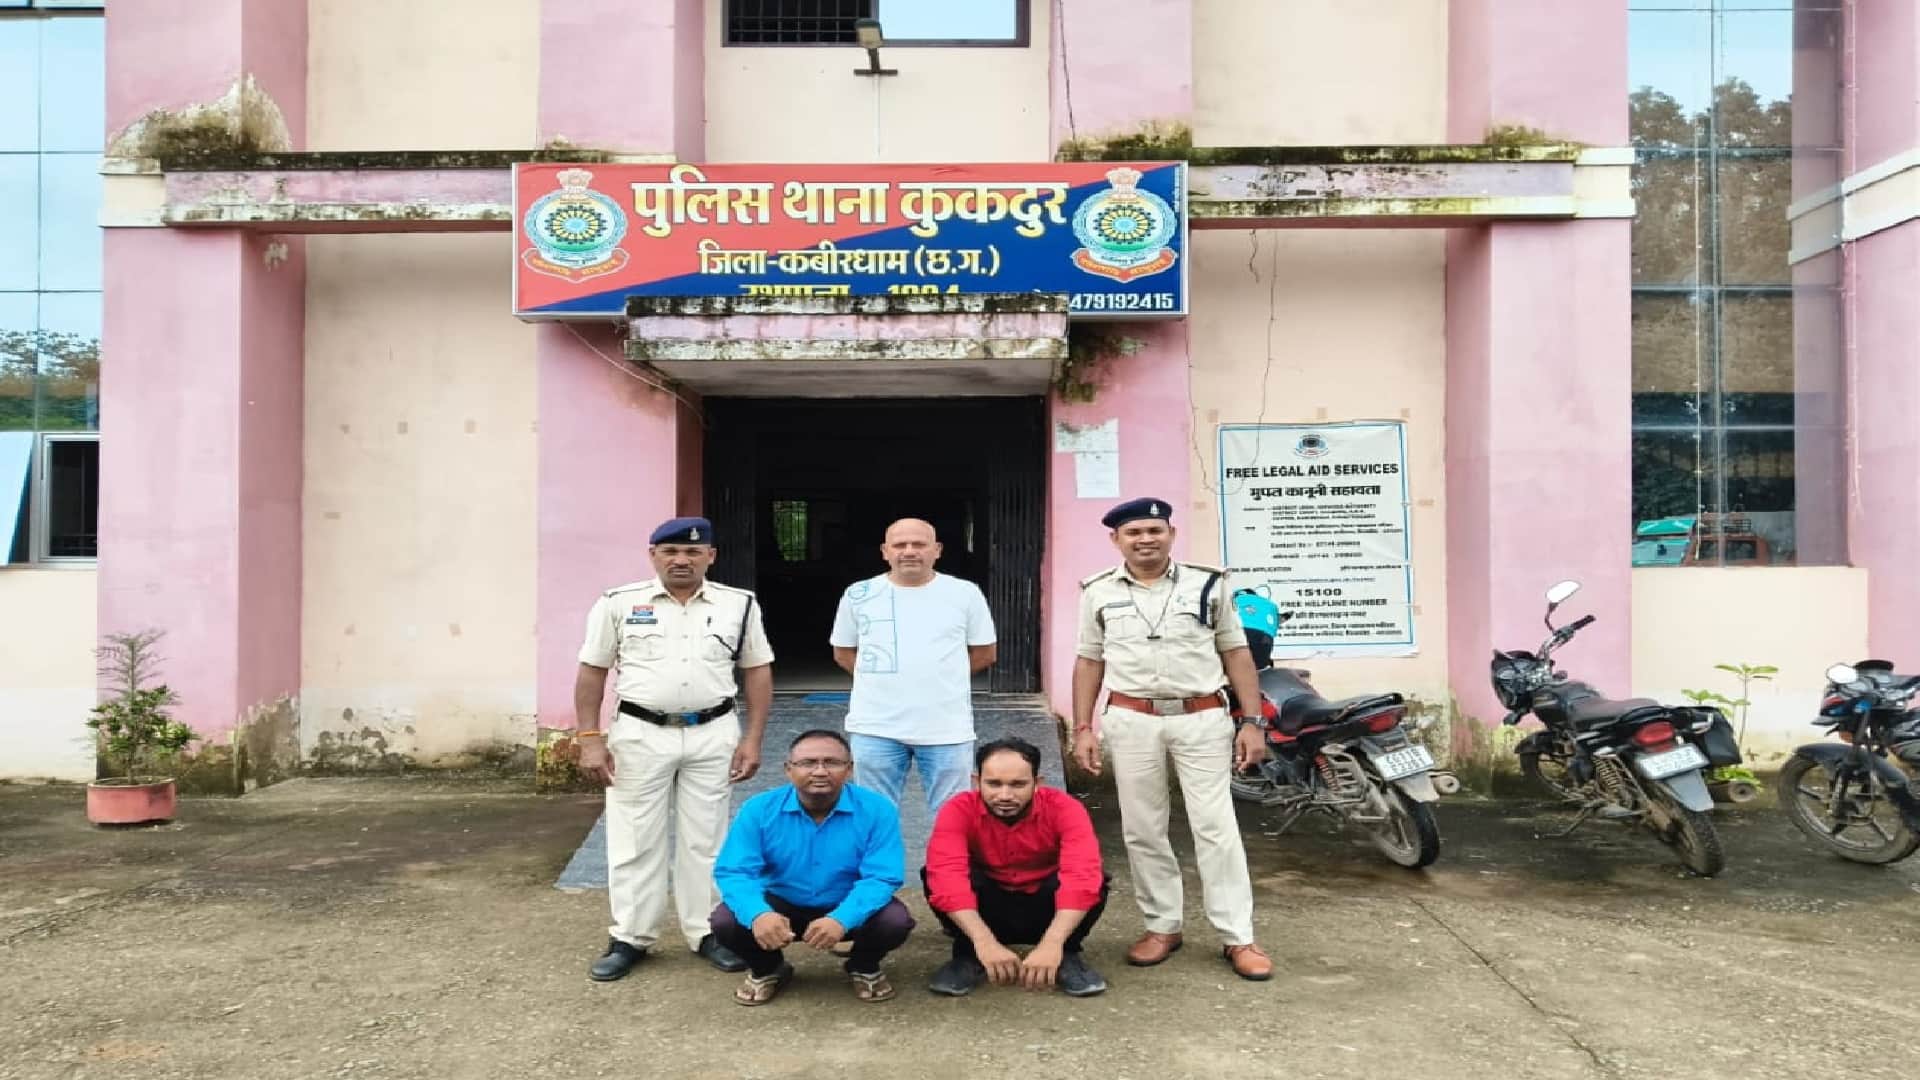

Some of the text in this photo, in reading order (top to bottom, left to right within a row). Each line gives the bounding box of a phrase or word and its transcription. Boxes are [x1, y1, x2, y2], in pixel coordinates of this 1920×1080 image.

[631, 164, 1070, 238] पुलिस थाना कुकदुर
[697, 239, 1001, 277] जिला-कबीरधाम (छ.ग.)
[1226, 463, 1399, 479] FREE LEGAL AID SERVICES
[1295, 588, 1342, 597] 15100
